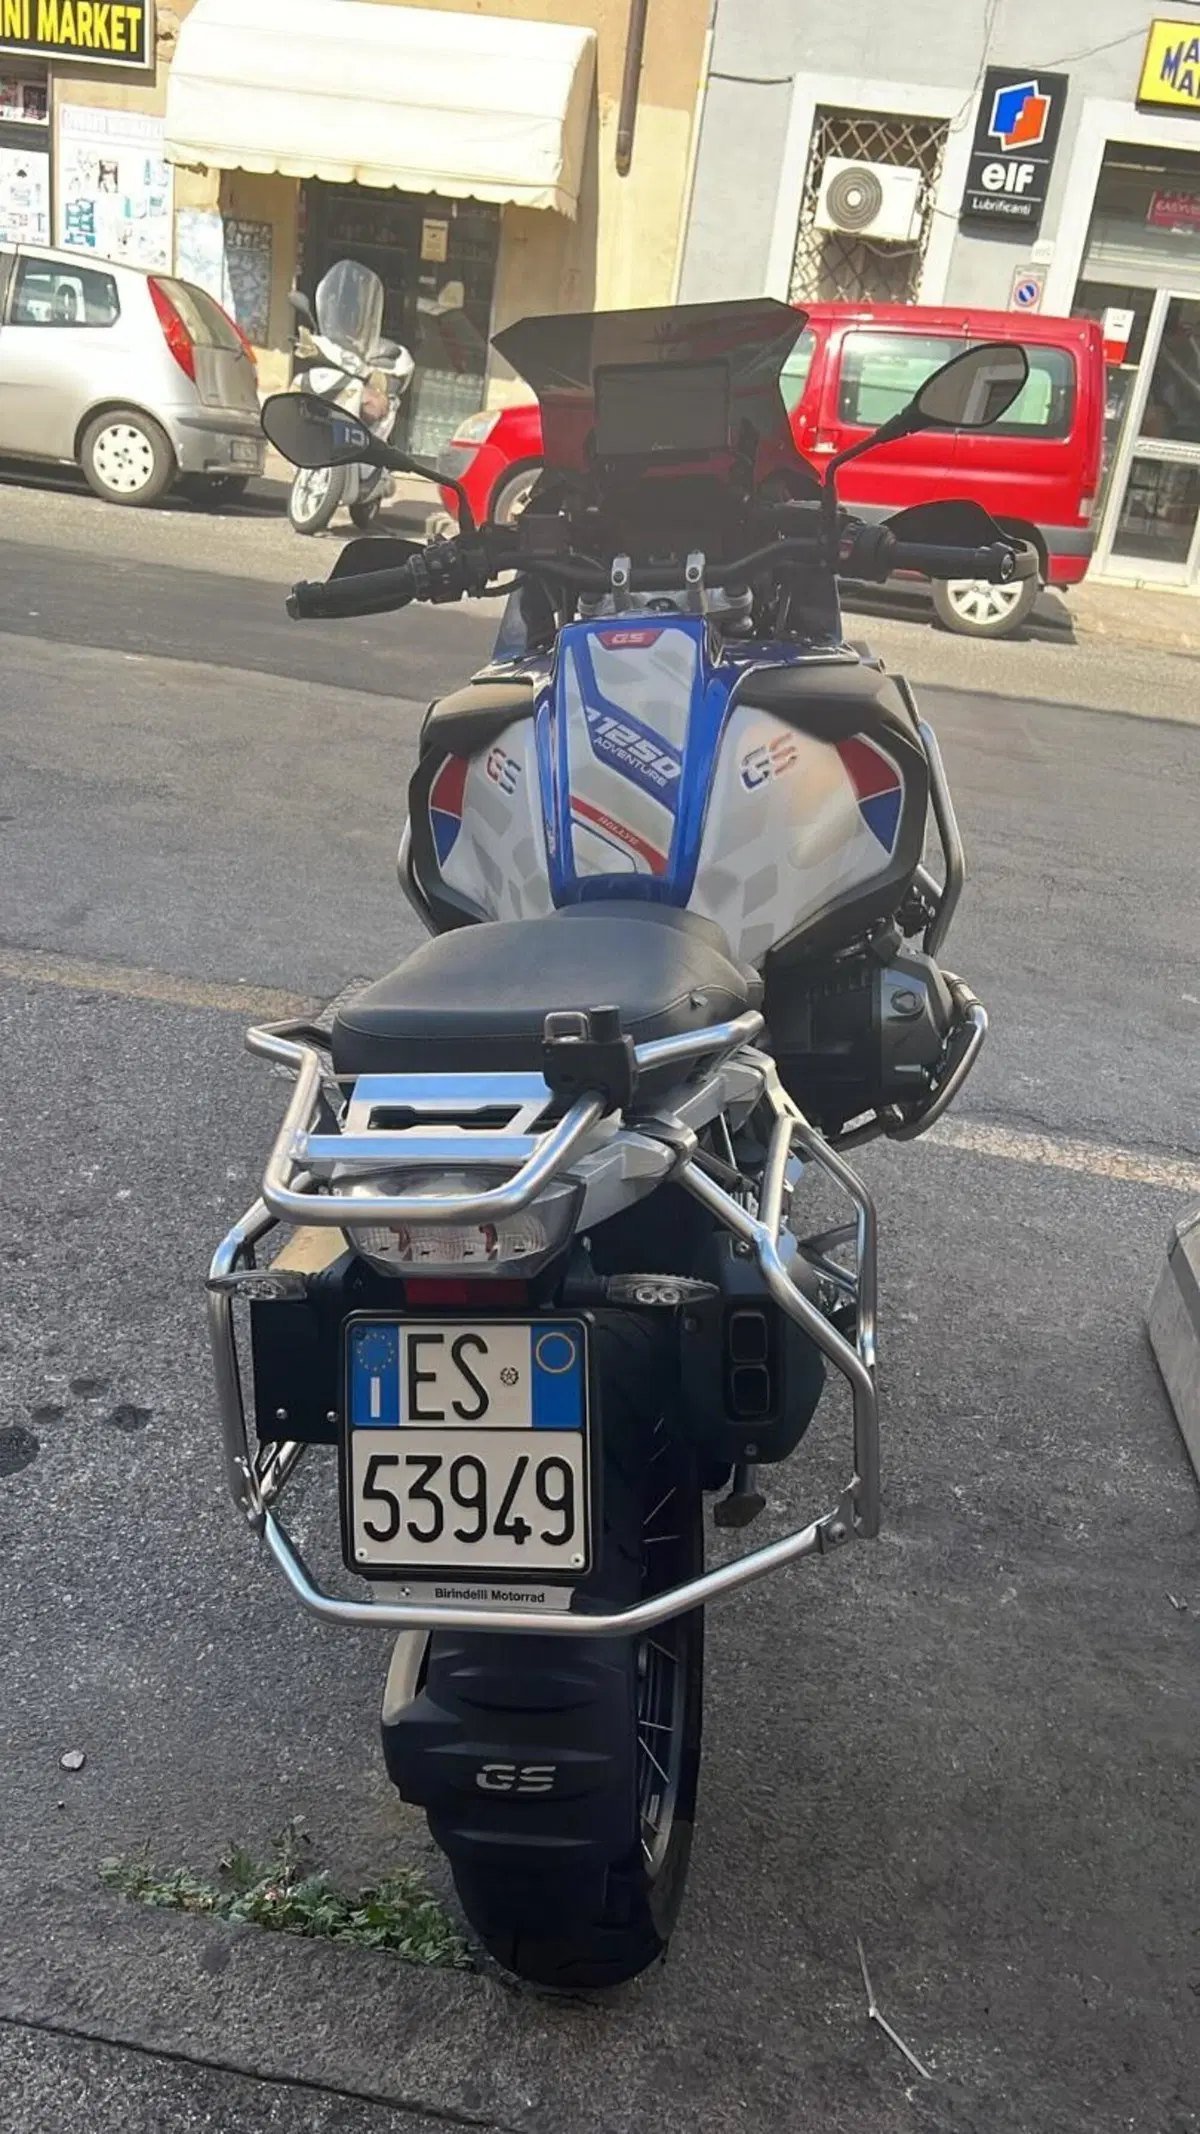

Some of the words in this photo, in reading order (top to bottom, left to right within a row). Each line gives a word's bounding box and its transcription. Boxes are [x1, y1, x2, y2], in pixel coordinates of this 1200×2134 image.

[37, 0, 142, 52] MARKET
[981, 162, 1035, 193] elf
[972, 197, 1032, 215] Lubrificanti
[611, 633, 645, 644] GS
[593, 736, 669, 787] ADVENTURE
[741, 732, 798, 790] GS
[407, 1333, 490, 1421] ES
[362, 1454, 575, 1546] 53949
[434, 1588, 488, 1600] Birindelli
[491, 1589, 546, 1603] Motorrad
[476, 1764, 556, 1792] GS
